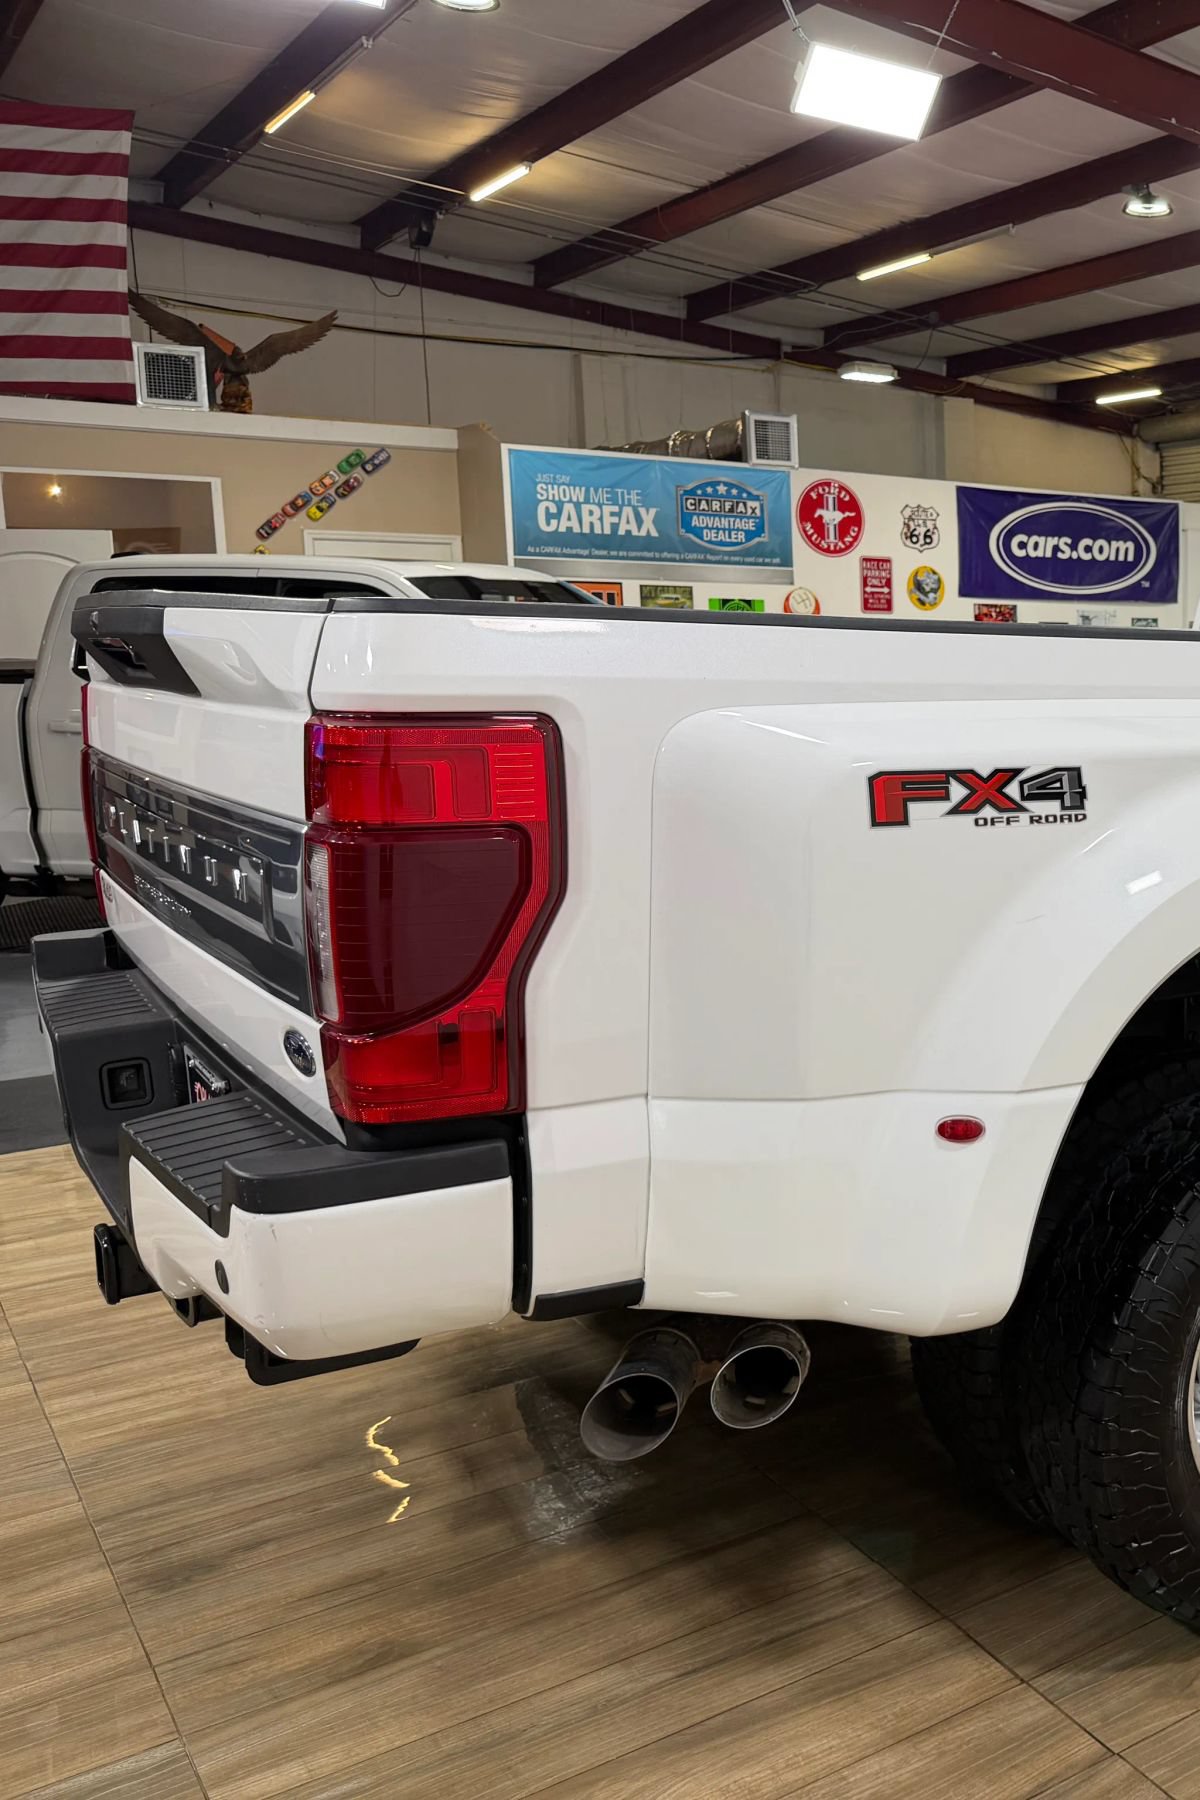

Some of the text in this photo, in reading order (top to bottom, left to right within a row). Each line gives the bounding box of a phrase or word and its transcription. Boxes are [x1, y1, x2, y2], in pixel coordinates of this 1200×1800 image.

[536, 473, 570, 484] JUST SAY
[536, 483, 643, 506] SHOW ME THE
[810, 484, 850, 501] FORD
[685, 498, 758, 516] CARFAX
[537, 500, 658, 537] CARFAX
[703, 529, 746, 543] DEALER
[802, 521, 859, 550] MUSTANG
[909, 528, 934, 546] 66
[1010, 534, 1135, 562] cars.com
[863, 569, 890, 578] PARKING
[866, 578, 886, 586] ONLY
[868, 766, 1087, 828] FX4
[974, 813, 1088, 827] OFF ROAD
